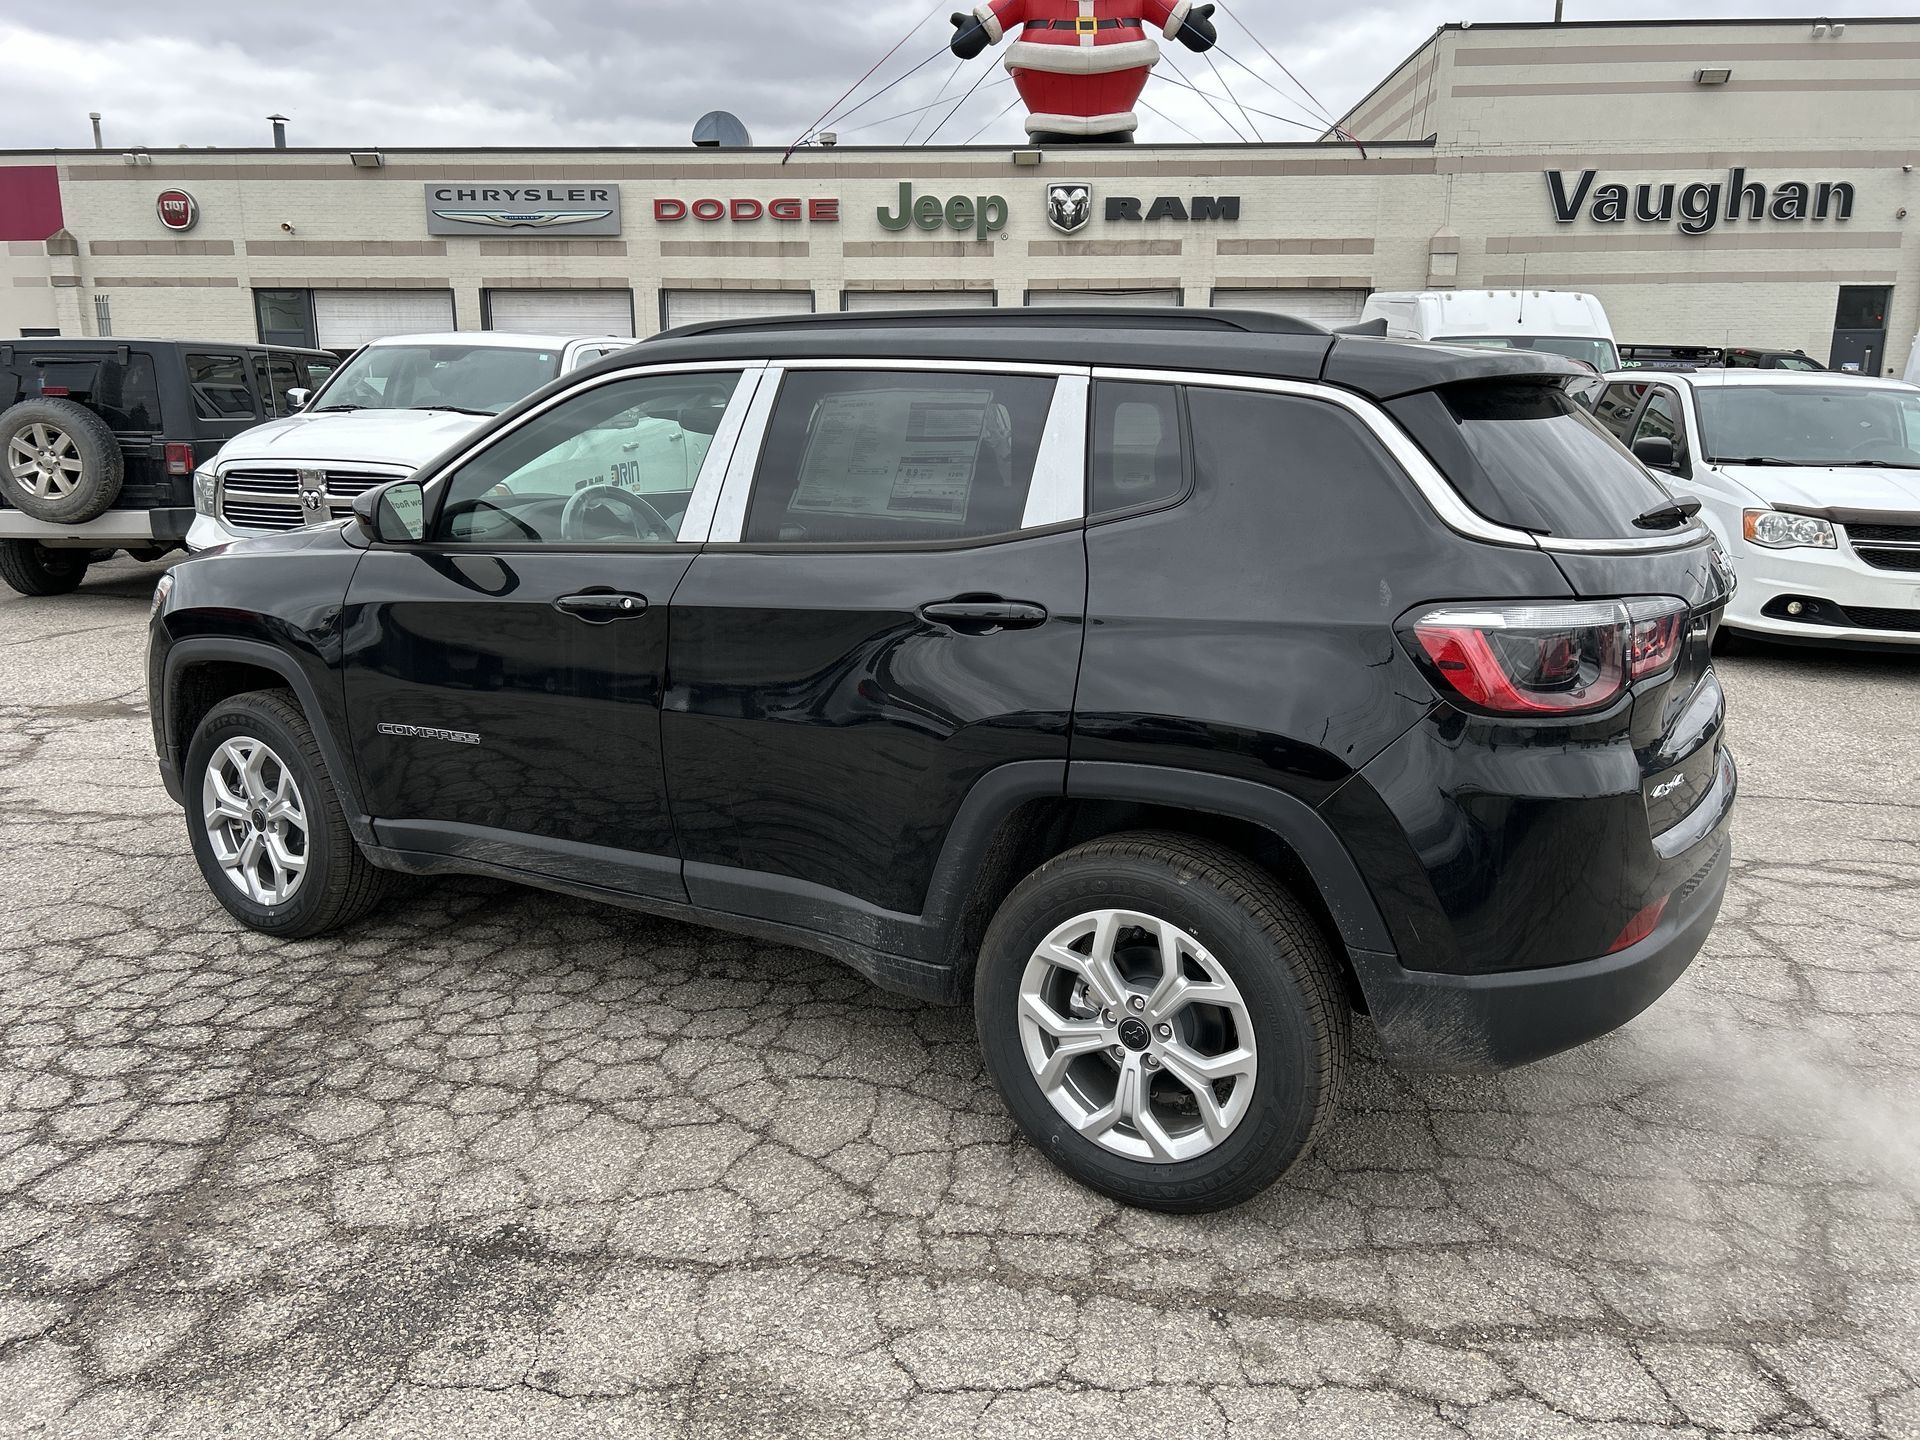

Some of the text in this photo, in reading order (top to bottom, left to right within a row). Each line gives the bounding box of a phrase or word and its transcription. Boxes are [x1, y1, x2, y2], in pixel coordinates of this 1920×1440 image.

[435, 189, 609, 201] CHRYSLER
[1544, 167, 1856, 235] Vaughan
[653, 198, 840, 221] DODGE
[877, 182, 1009, 240] Jeep
[1105, 196, 1240, 221] RAM
[377, 722, 481, 745] COMPASS
